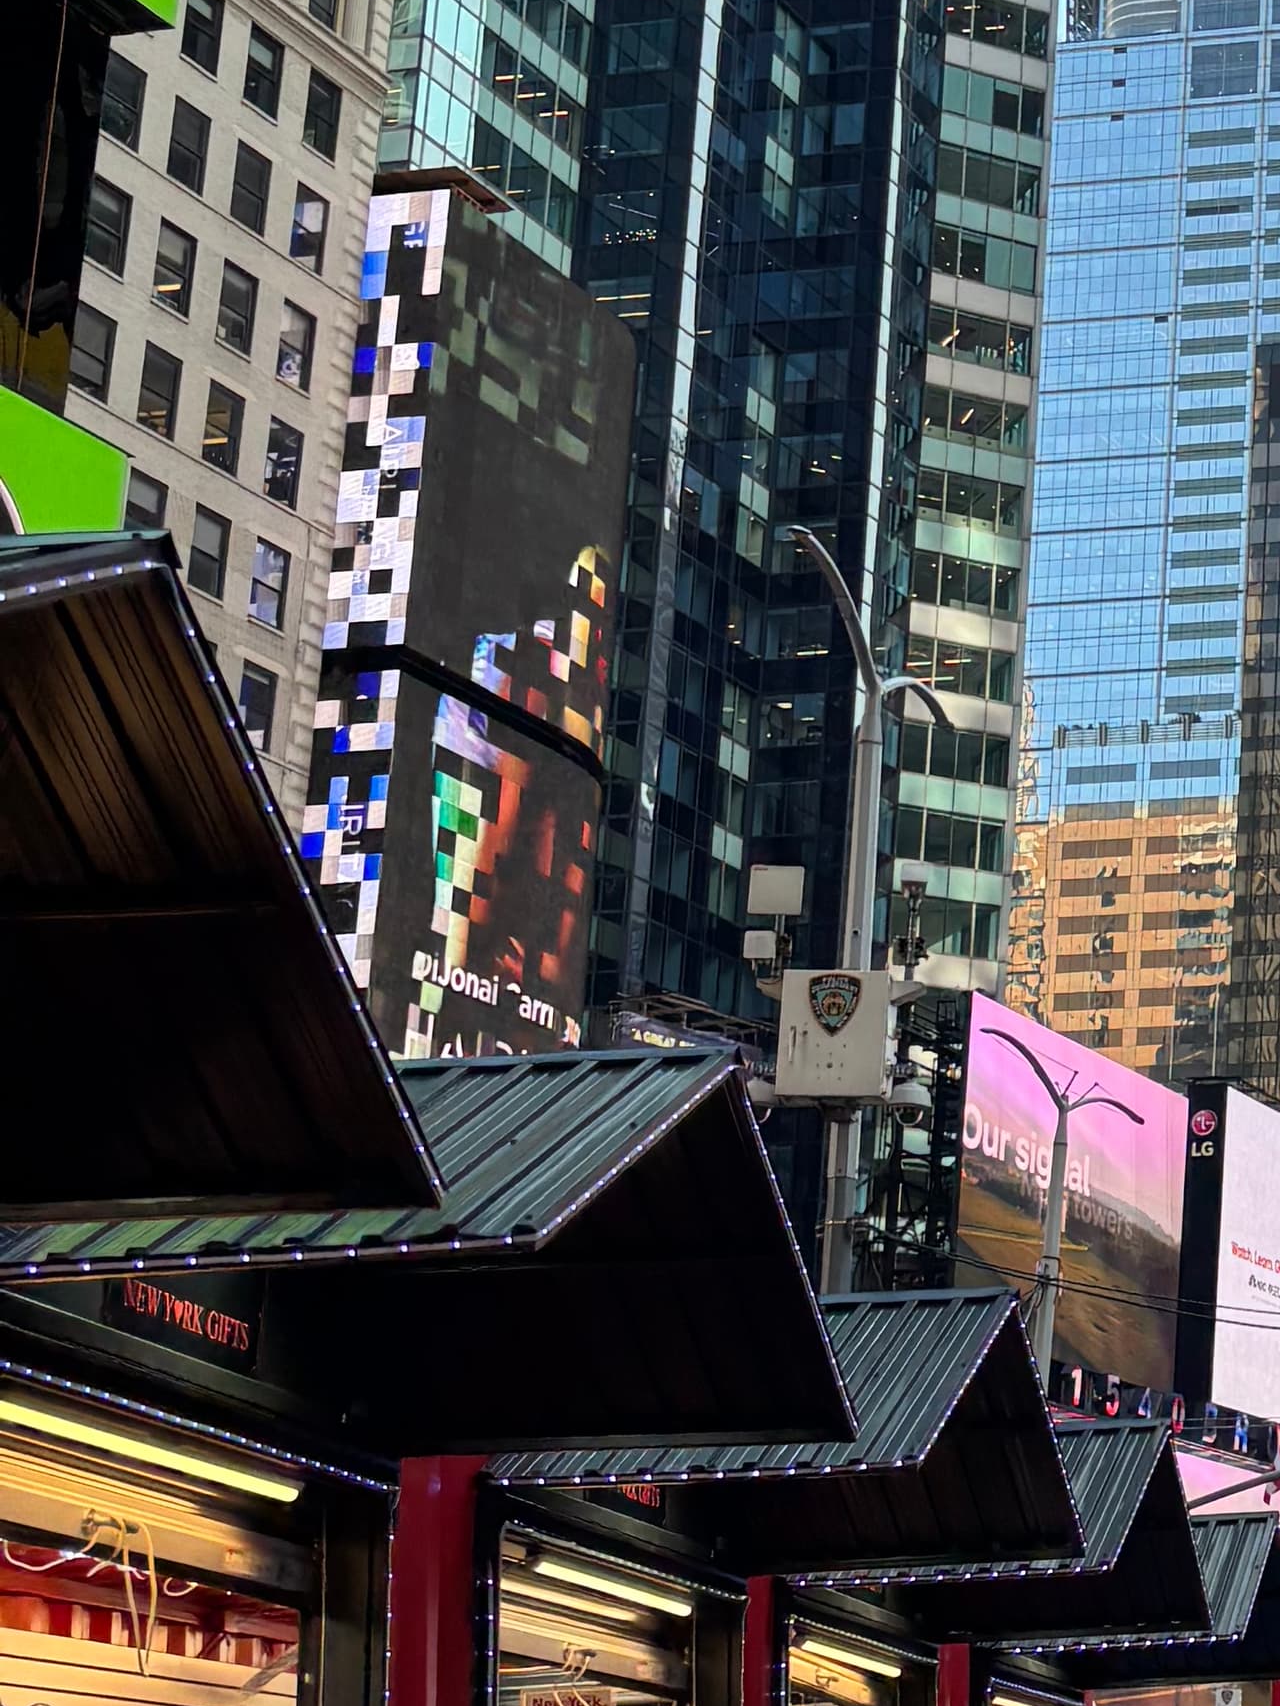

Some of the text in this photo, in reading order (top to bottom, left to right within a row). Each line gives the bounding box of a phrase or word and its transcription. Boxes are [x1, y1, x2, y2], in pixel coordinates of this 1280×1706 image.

[962, 1103, 1011, 1162] Our
[1014, 1130, 1090, 1197] sigal
[1191, 1141, 1215, 1158] LG
[123, 1278, 162, 1317] NEW
[206, 1310, 249, 1351] GIFTS
